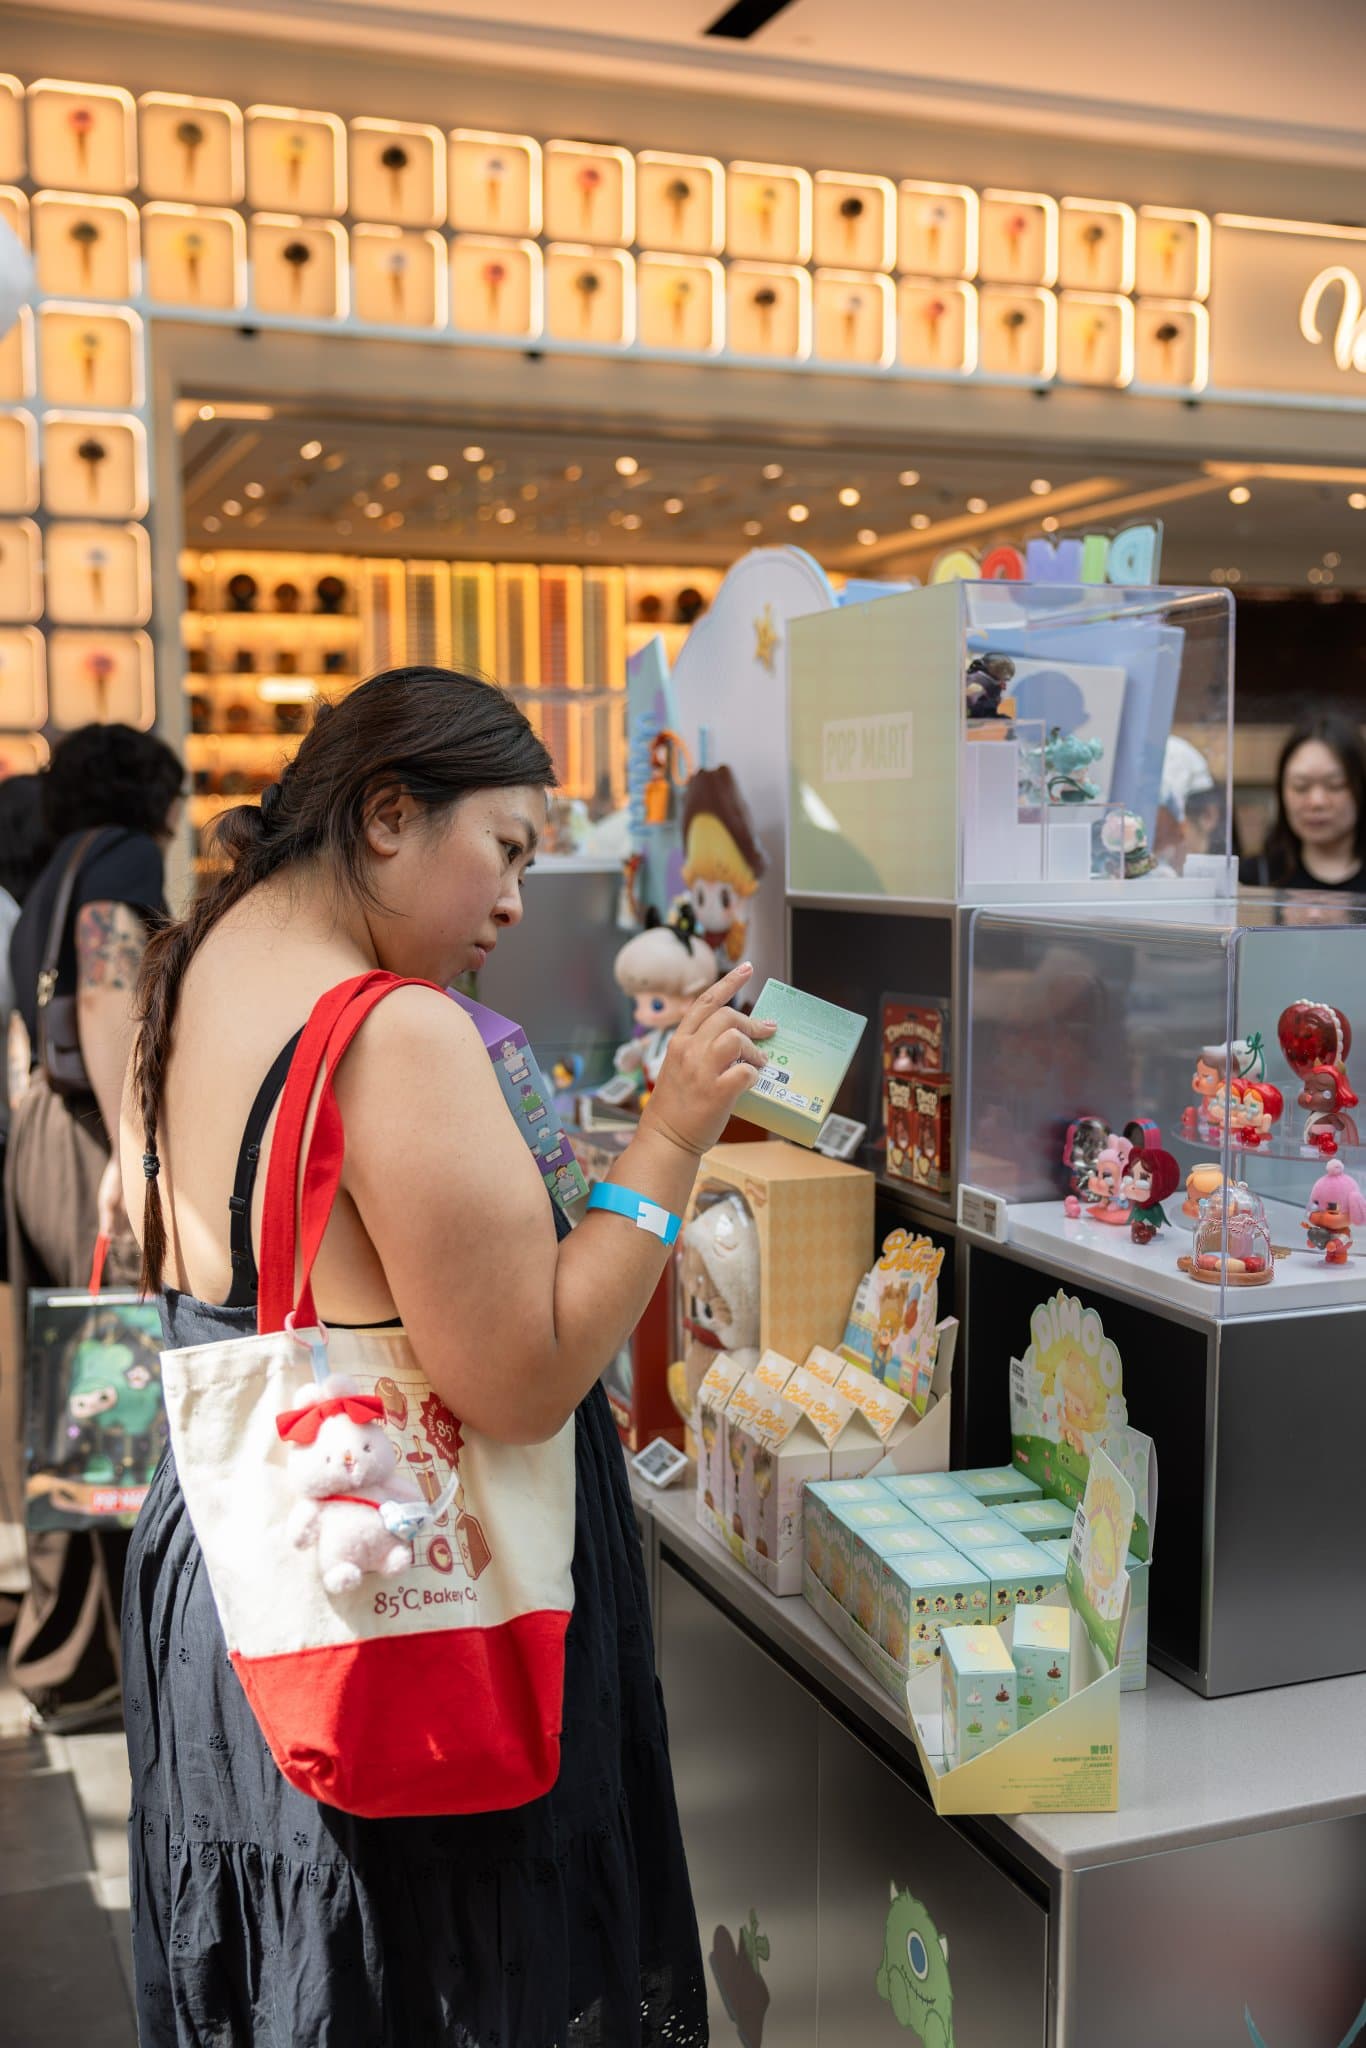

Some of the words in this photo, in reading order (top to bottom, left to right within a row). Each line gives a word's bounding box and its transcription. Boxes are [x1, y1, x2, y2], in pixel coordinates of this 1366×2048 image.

[827, 728, 856, 774] POP
[861, 722, 908, 769] MART
[1034, 1302, 1121, 1390] DIMOO
[423, 1588, 464, 1605] Bakery
